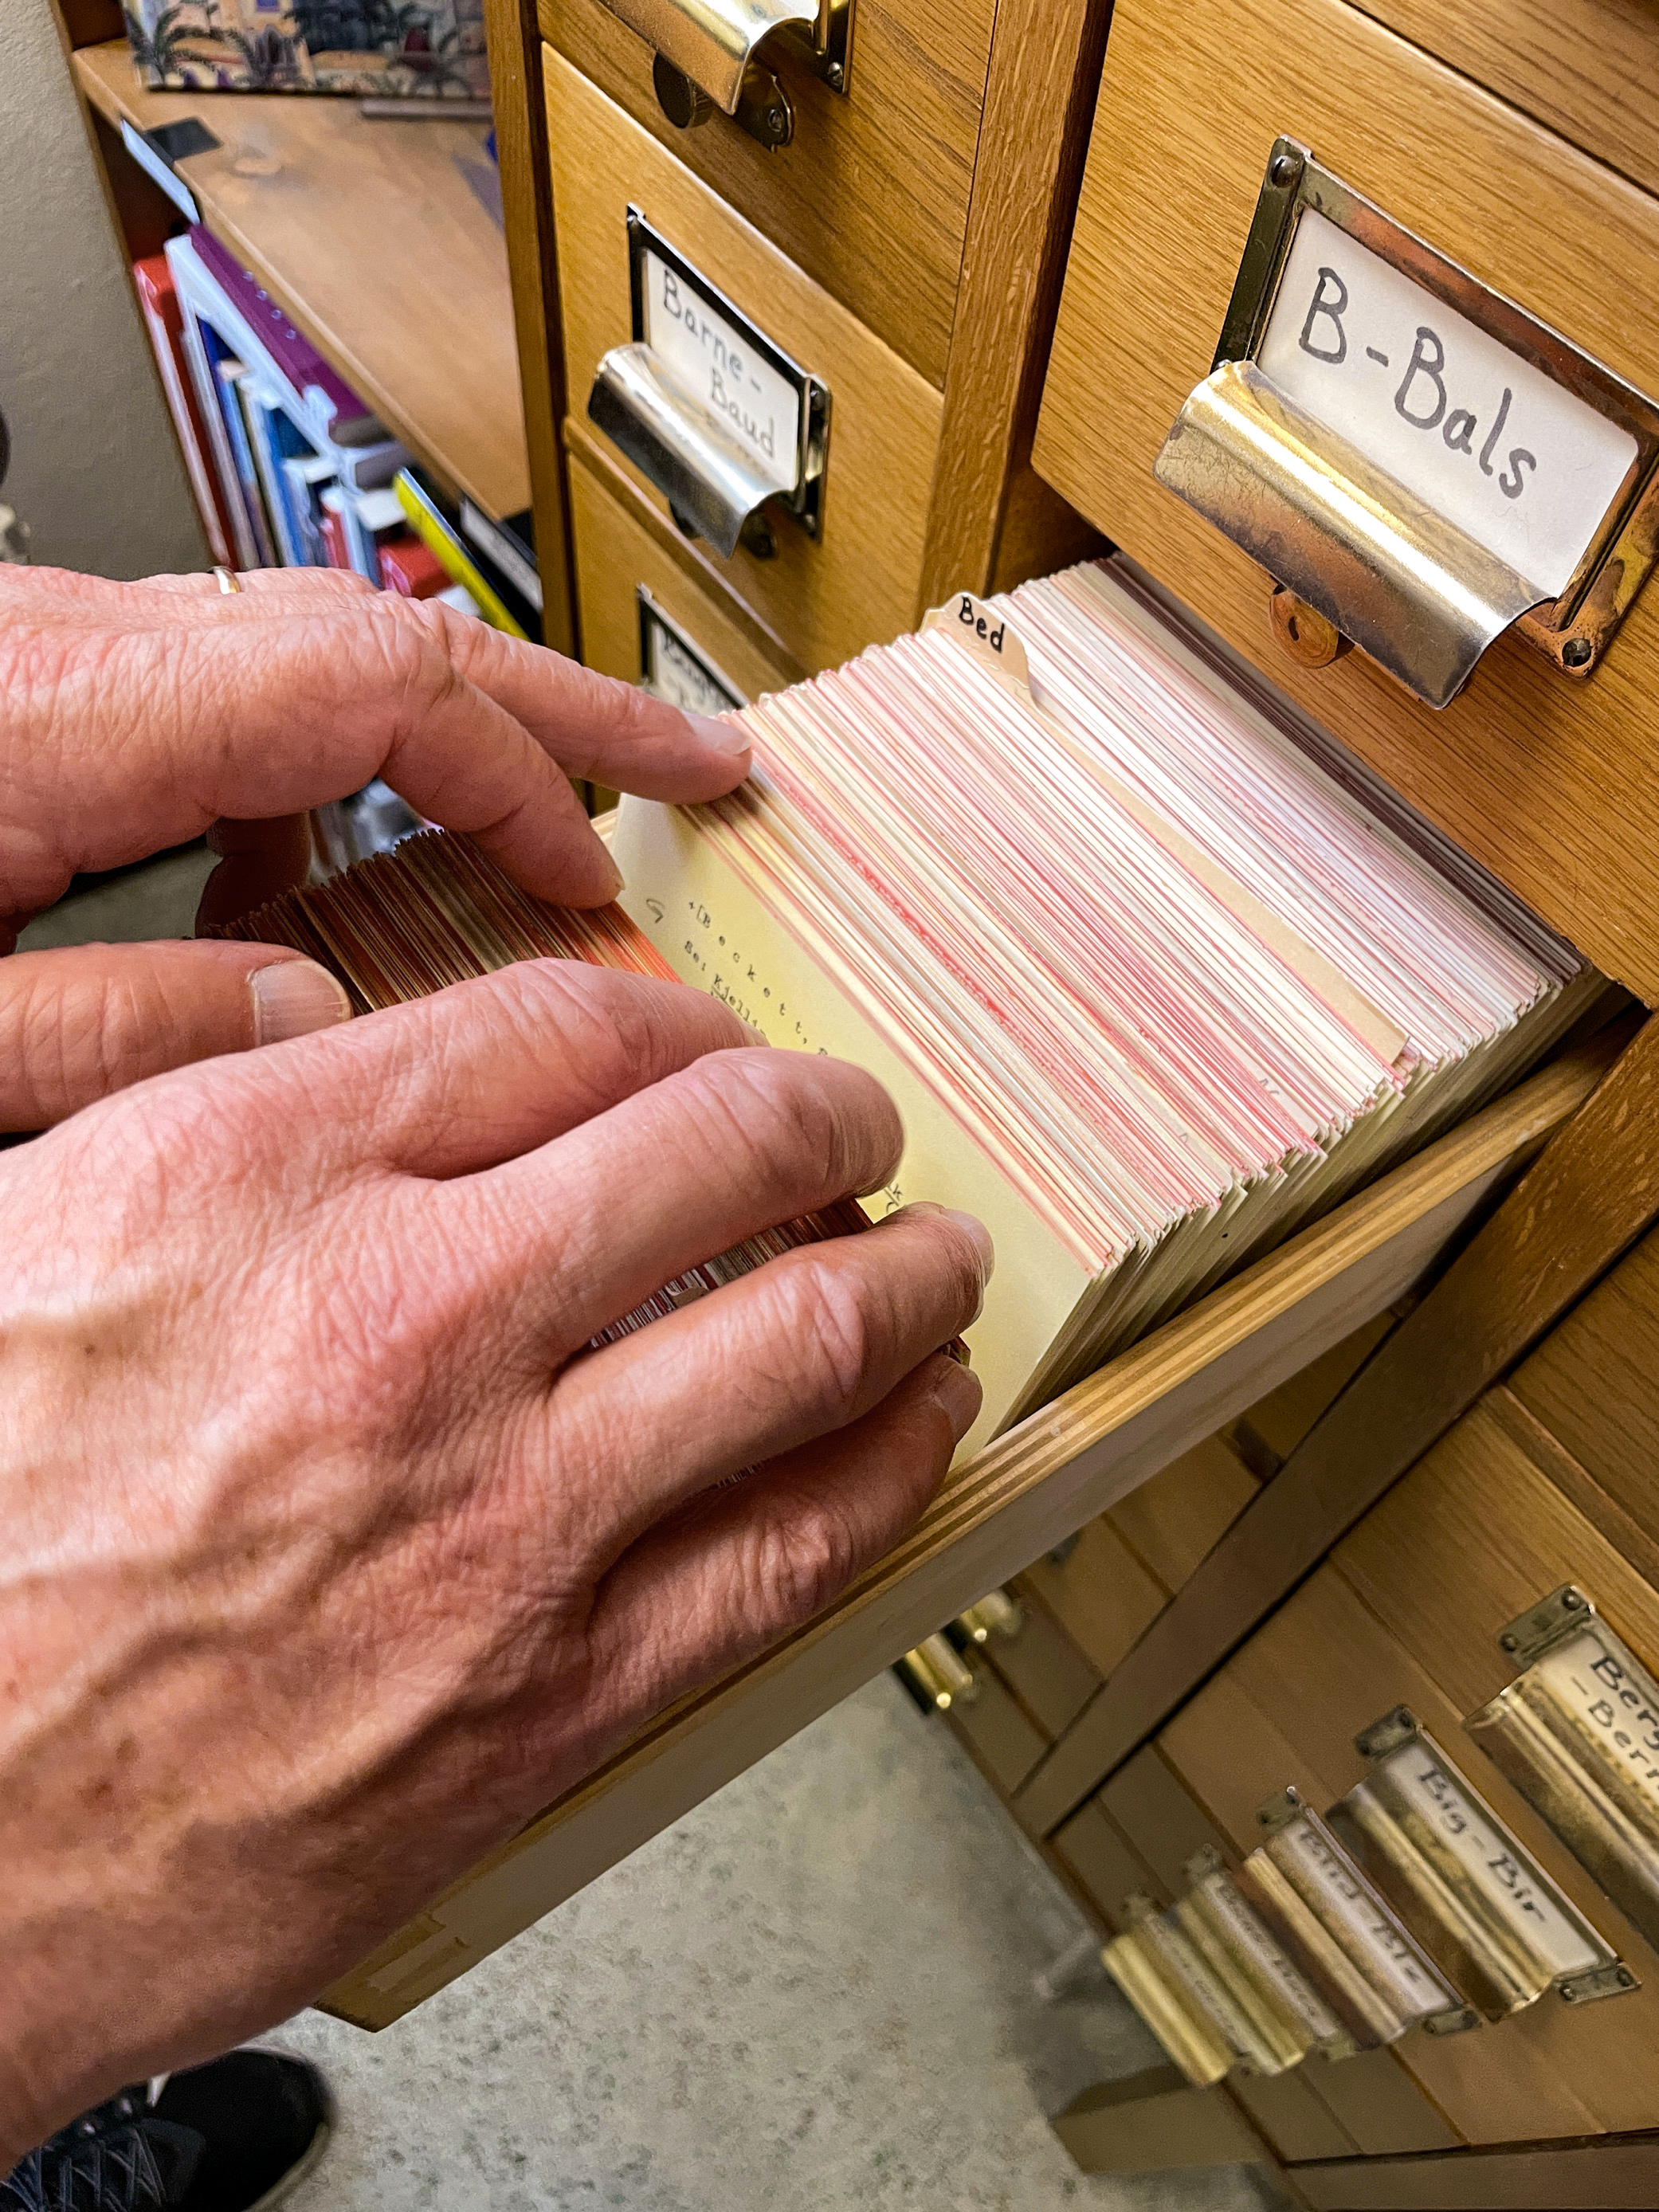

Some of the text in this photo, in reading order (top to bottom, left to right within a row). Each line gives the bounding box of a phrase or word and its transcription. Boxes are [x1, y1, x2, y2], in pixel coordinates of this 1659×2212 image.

[711, 367, 775, 459] Baud
[1299, 267, 1537, 500] B-Bals
[959, 596, 1006, 654] Bed
